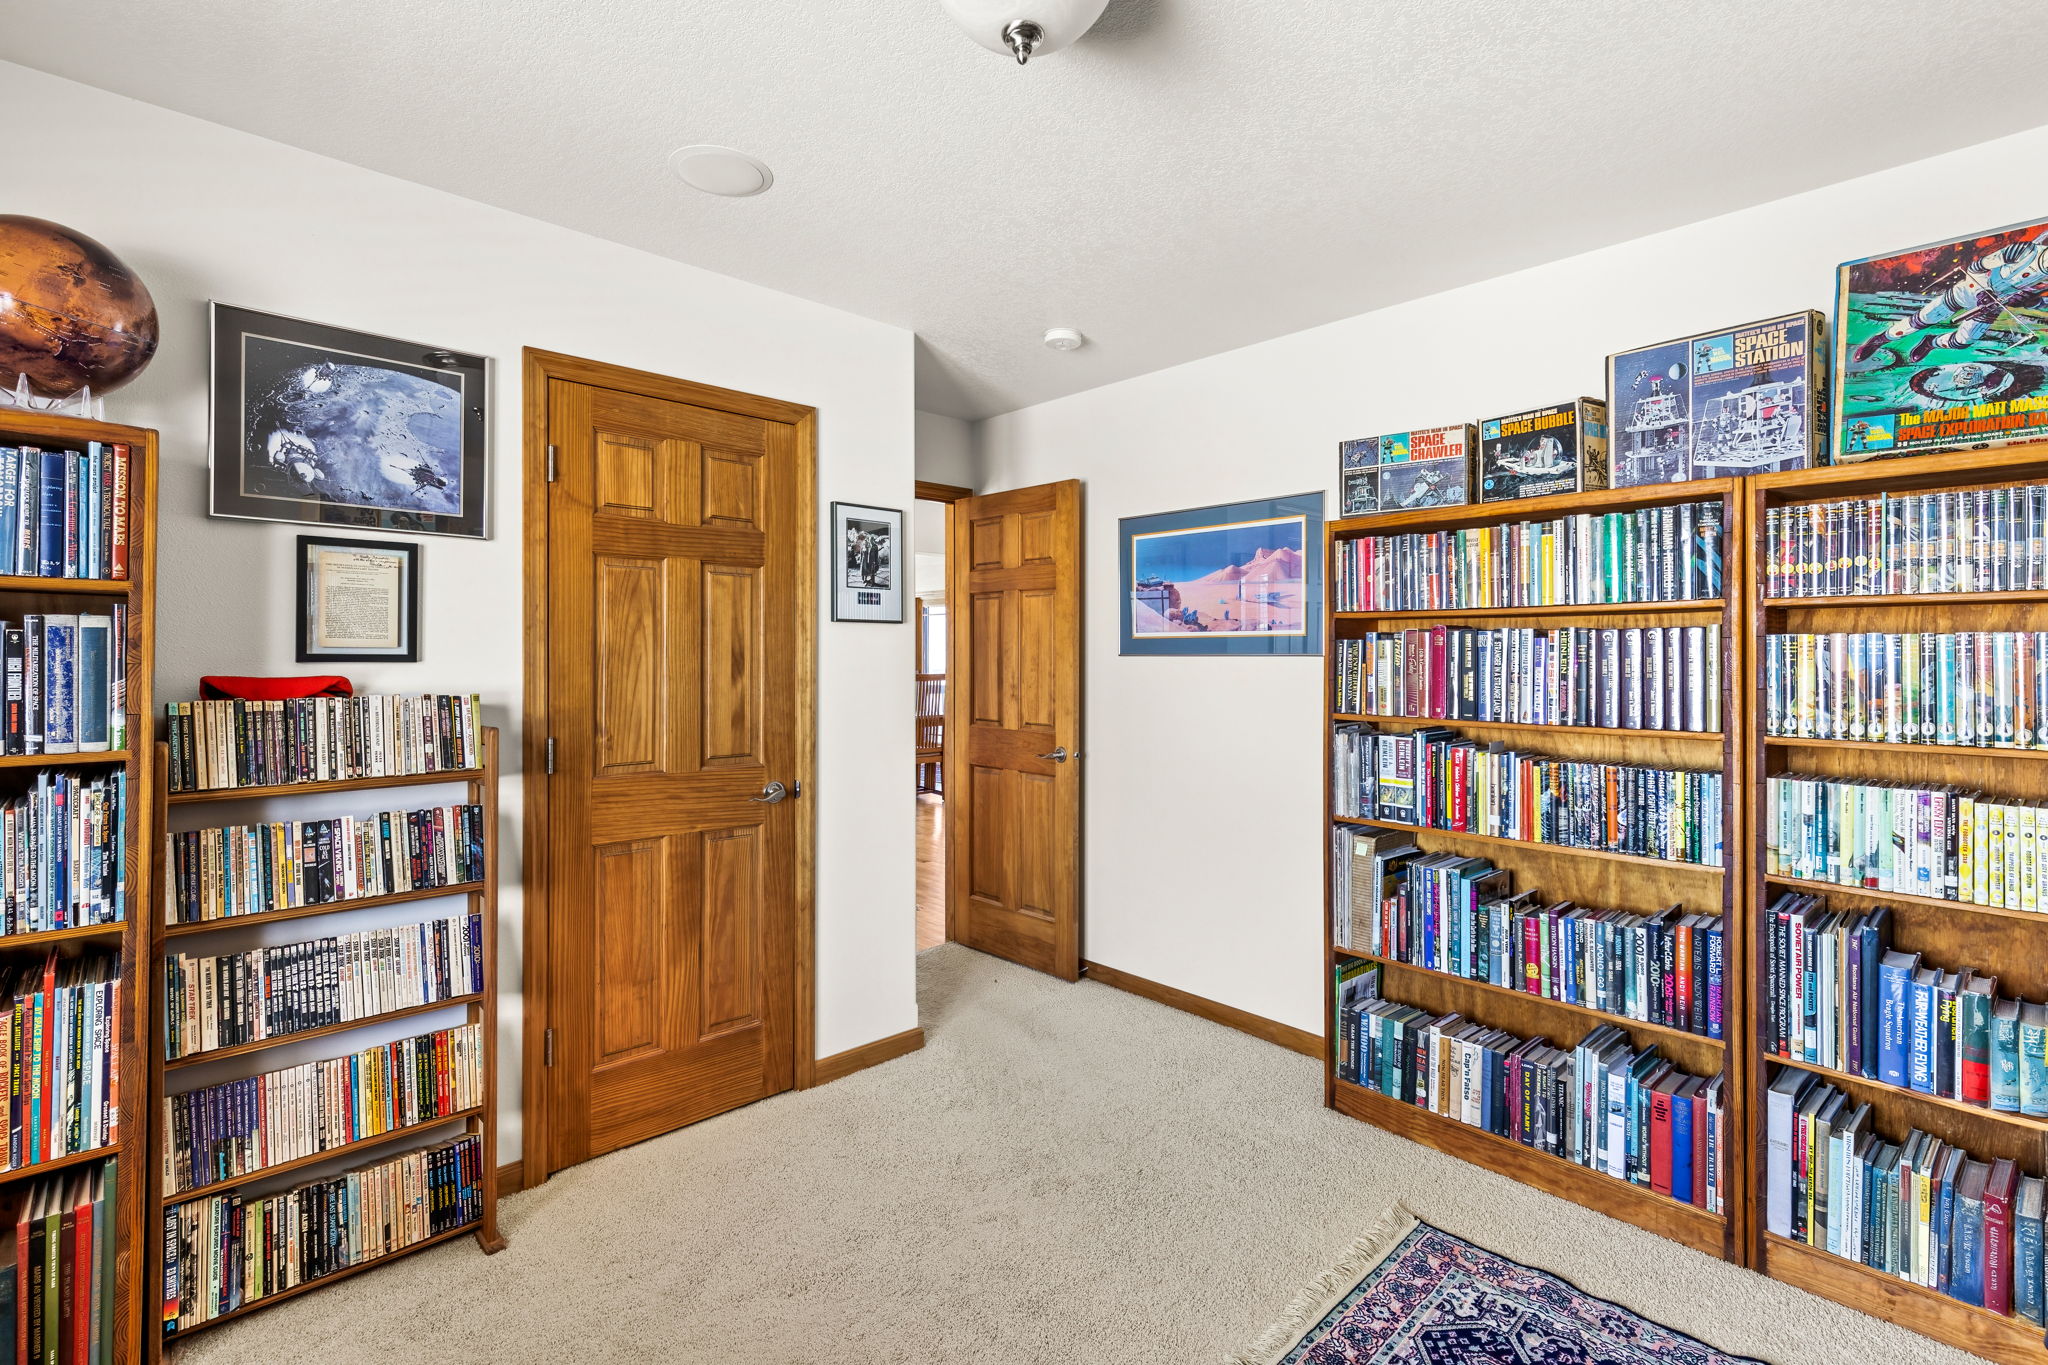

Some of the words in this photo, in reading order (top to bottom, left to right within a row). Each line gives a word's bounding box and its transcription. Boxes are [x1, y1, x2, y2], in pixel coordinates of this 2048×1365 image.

[1736, 329, 1788, 352] SPACE
[1736, 341, 1804, 368] STATION
[1542, 408, 1558, 416] SPACE
[1899, 412, 1920, 426] The
[1923, 406, 1969, 423] MAJOR
[1973, 401, 2007, 418] MATT
[1448, 424, 1463, 432] SPACE
[1501, 420, 1532, 437] SPACE
[1535, 410, 1574, 432] BUBBLE
[1898, 425, 1936, 441] SPACE
[1940, 414, 2025, 437] EXPLORATION
[1410, 433, 1445, 449] SPACE
[104, 453, 112, 471] PROJECT
[1410, 444, 1462, 462] CRAWLER
[5, 450, 17, 485] TARGET
[115, 457, 126, 498] MISSION
[104, 472, 112, 486] MARS
[4, 489, 15, 506] FOR
[115, 501, 126, 515] TO
[114, 517, 125, 545] MARS
[1560, 631, 1568, 674] HEINLEIN
[8, 658, 22, 672] HIGH
[8, 673, 22, 700] FRONTIER
[1493, 701, 1501, 713] LAND
[1398, 741, 1406, 770] HEINLEIN
[462, 926, 470, 943] 2001
[1636, 933, 1645, 956] 2001
[1768, 924, 1776, 952] Encyclopedia
[1597, 943, 1605, 969] APOLLO
[1694, 934, 1702, 970] ARTEMIS
[1597, 976, 1605, 988] GO
[1651, 960, 1660, 987] 2010:
[1665, 973, 1674, 998] 2061:
[1694, 976, 1702, 998] ANDY
[34, 1007, 42, 1016] BY
[94, 990, 103, 1027] EXPLORING
[1884, 999, 1893, 1019] Beagle
[34, 1017, 42, 1035] SPACE
[1896, 1014, 1904, 1044] American
[1915, 991, 1927, 1051] FAIR-WEATHER
[33, 1038, 41, 1051] SHIP
[94, 1029, 102, 1050] SPACE
[1884, 1020, 1893, 1050] Squadron
[33, 1053, 40, 1062] TO
[1464, 1053, 1472, 1076] Cap'n
[1915, 1053, 1927, 1082] FLYING
[83, 1061, 91, 1085] SPACE
[32, 1077, 40, 1099] MOON
[167, 1217, 177, 1231] LOST
[166, 1239, 177, 1258] SPACE
[33, 1266, 41, 1283] MARS
[167, 1266, 177, 1274] ED
[33, 1285, 41, 1294] AS
[167, 1276, 176, 1299] SHIFRES
[33, 1296, 41, 1317] VIEWED
